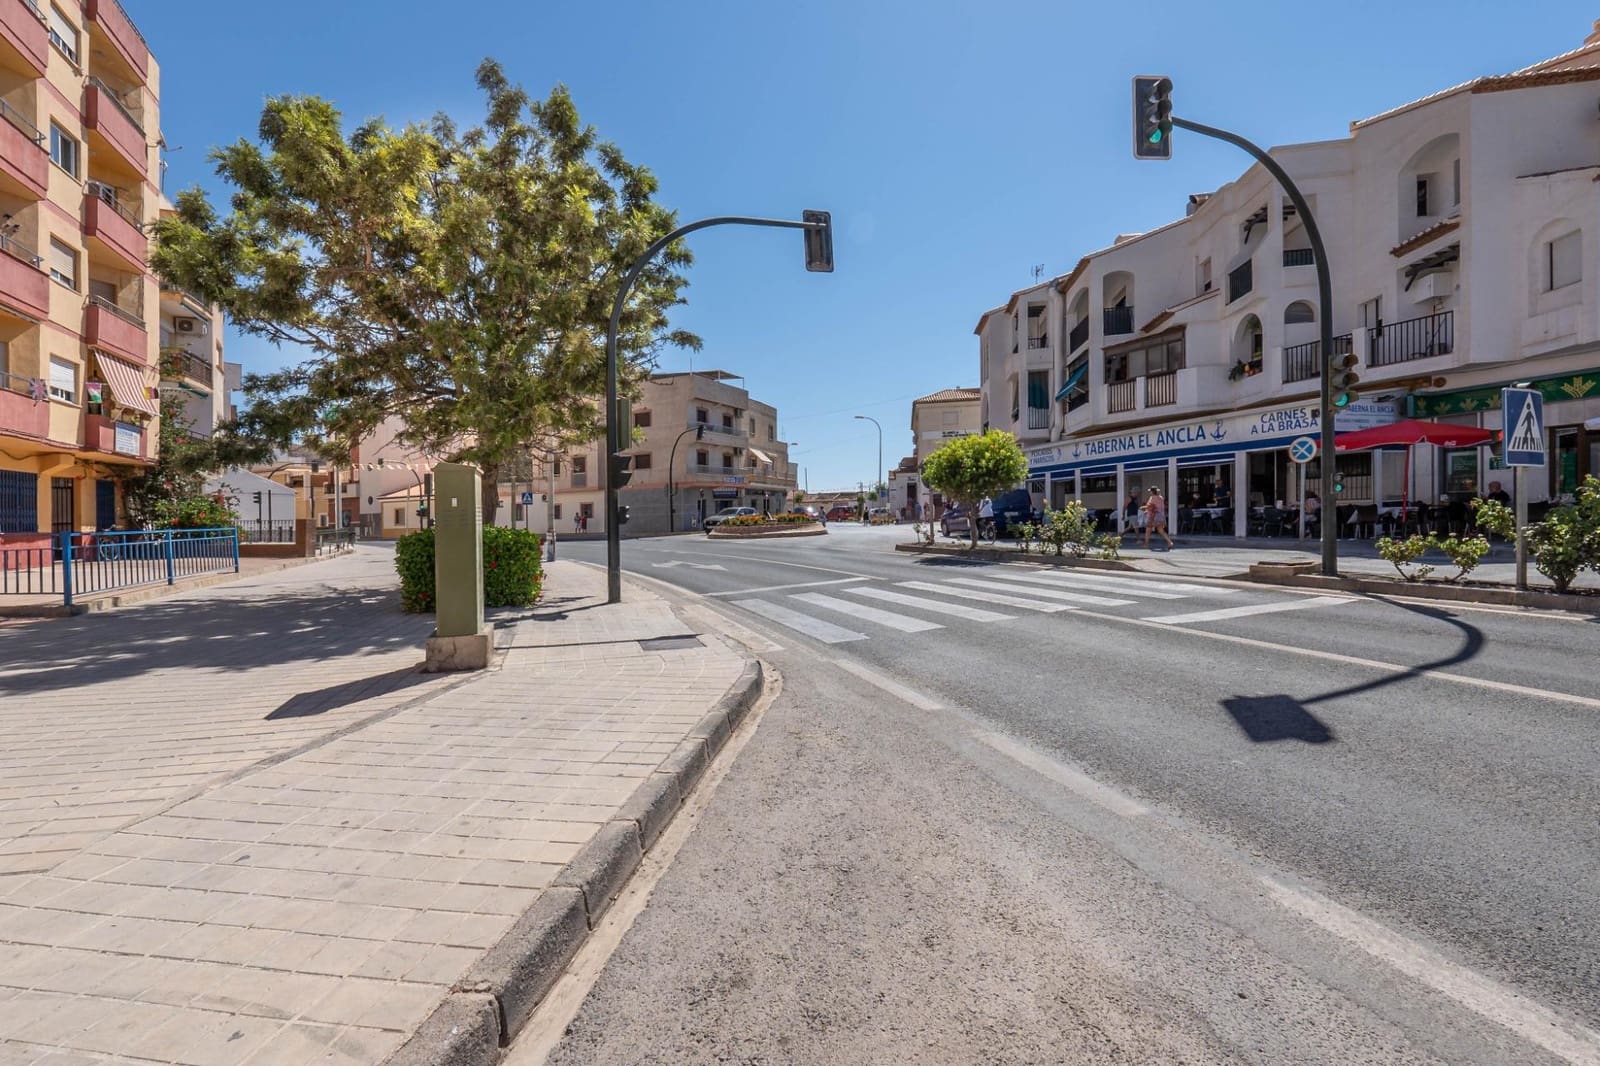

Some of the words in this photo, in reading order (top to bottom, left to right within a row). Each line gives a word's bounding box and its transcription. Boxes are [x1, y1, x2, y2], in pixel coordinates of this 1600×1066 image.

[1261, 408, 1307, 424] CARNES
[1250, 425, 1258, 435] A
[1261, 423, 1275, 433] LA
[1278, 417, 1319, 431] BRASA
[1084, 436, 1134, 456] TABERNA
[1138, 433, 1151, 449] EL
[1156, 425, 1206, 446] ANCLA
